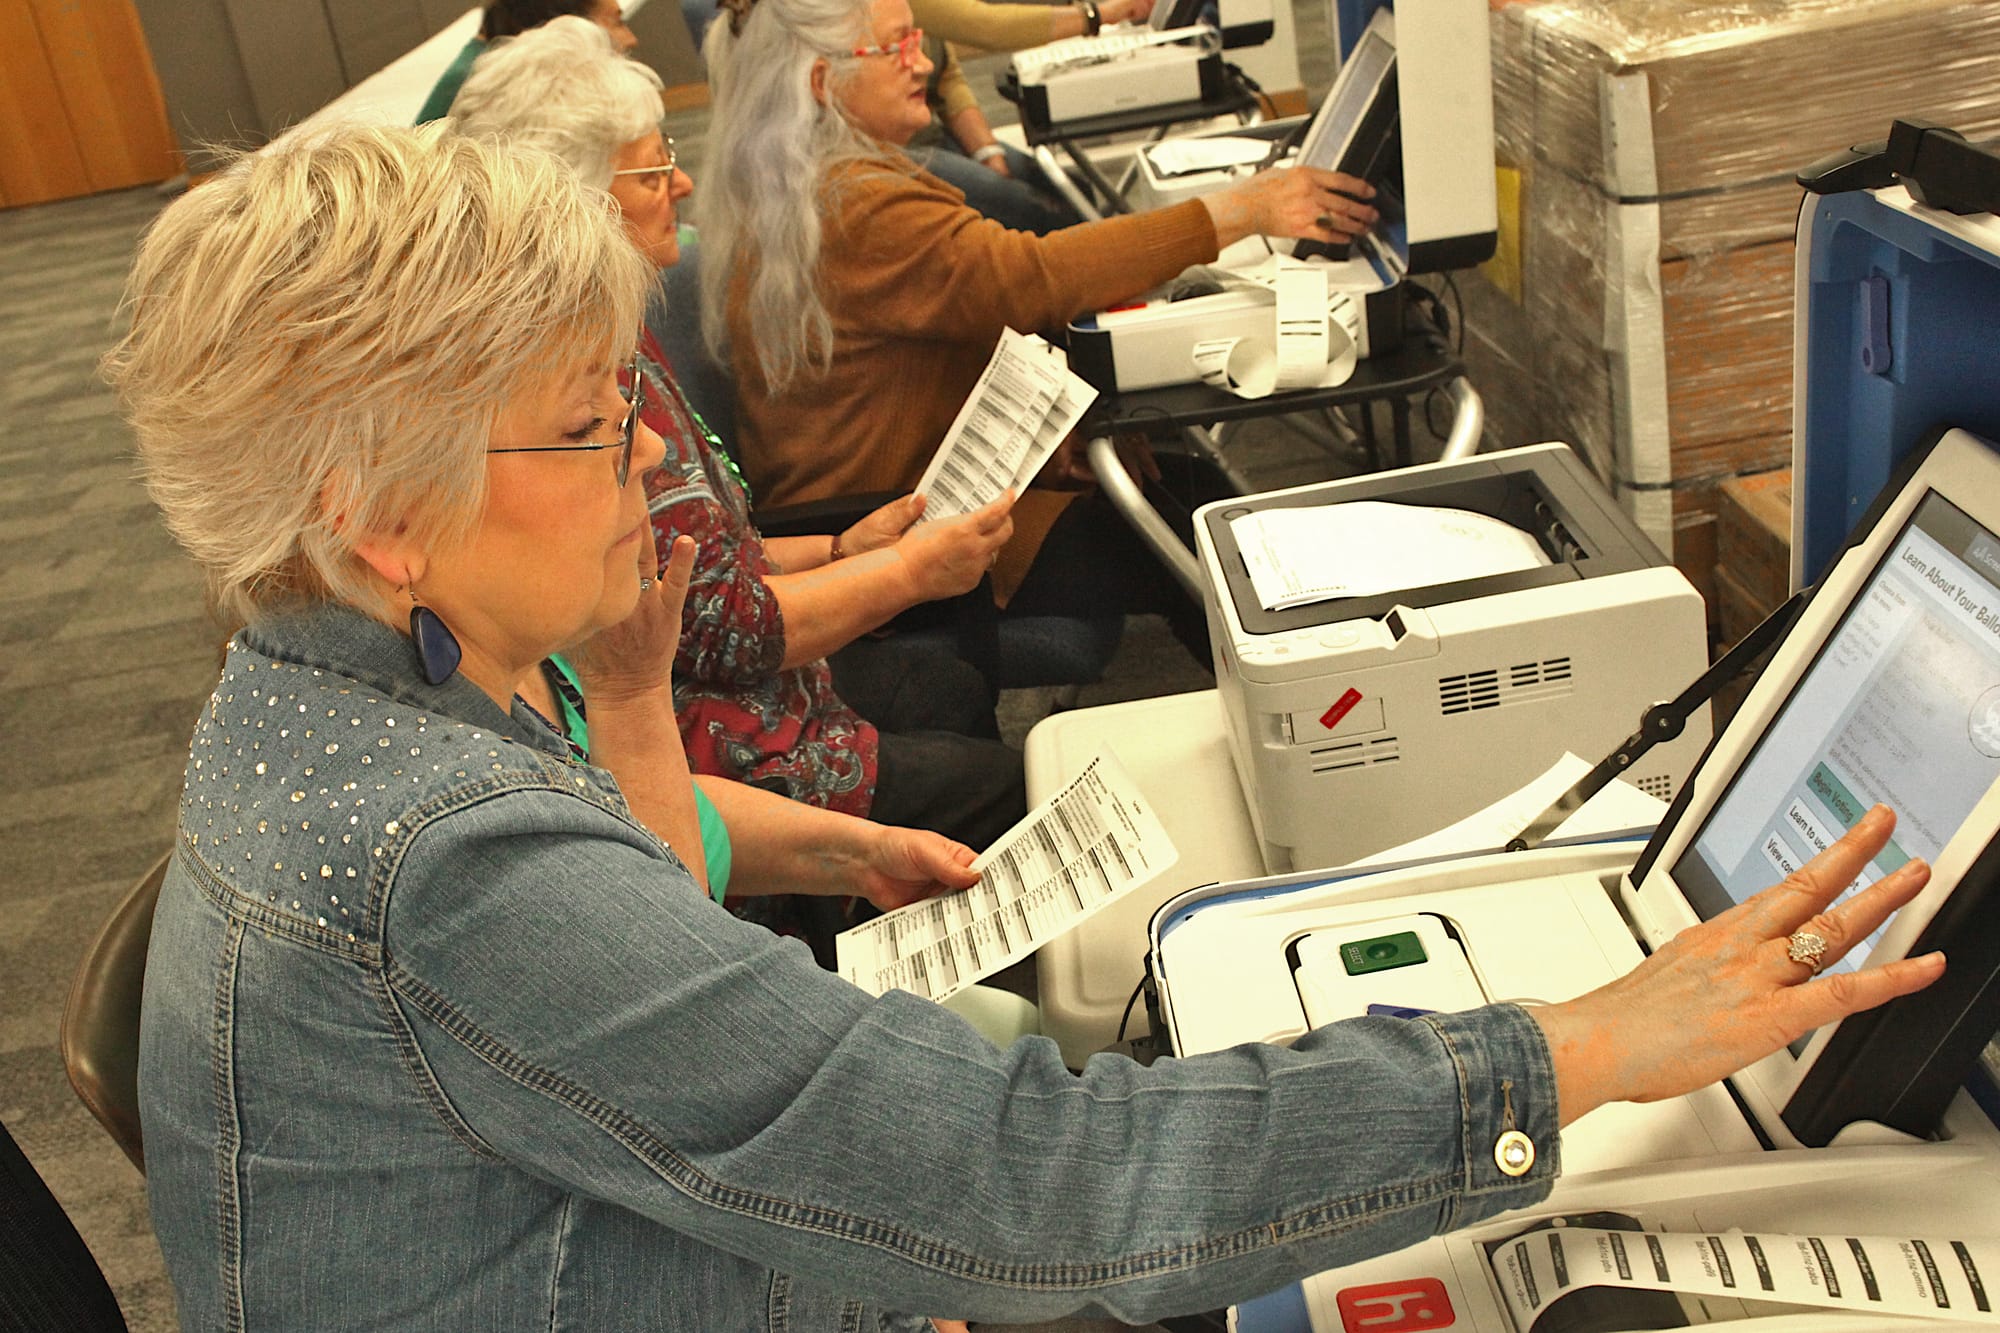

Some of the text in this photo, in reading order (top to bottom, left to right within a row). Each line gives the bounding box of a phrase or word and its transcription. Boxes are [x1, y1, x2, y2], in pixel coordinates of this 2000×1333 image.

[1902, 547, 2000, 637] Learn About Your Ballo
[1813, 771, 1854, 823] Begin Voting
[1767, 838, 1783, 862] View
[1789, 805, 1827, 852] Learn to use
[1348, 946, 1364, 965] SELECT
